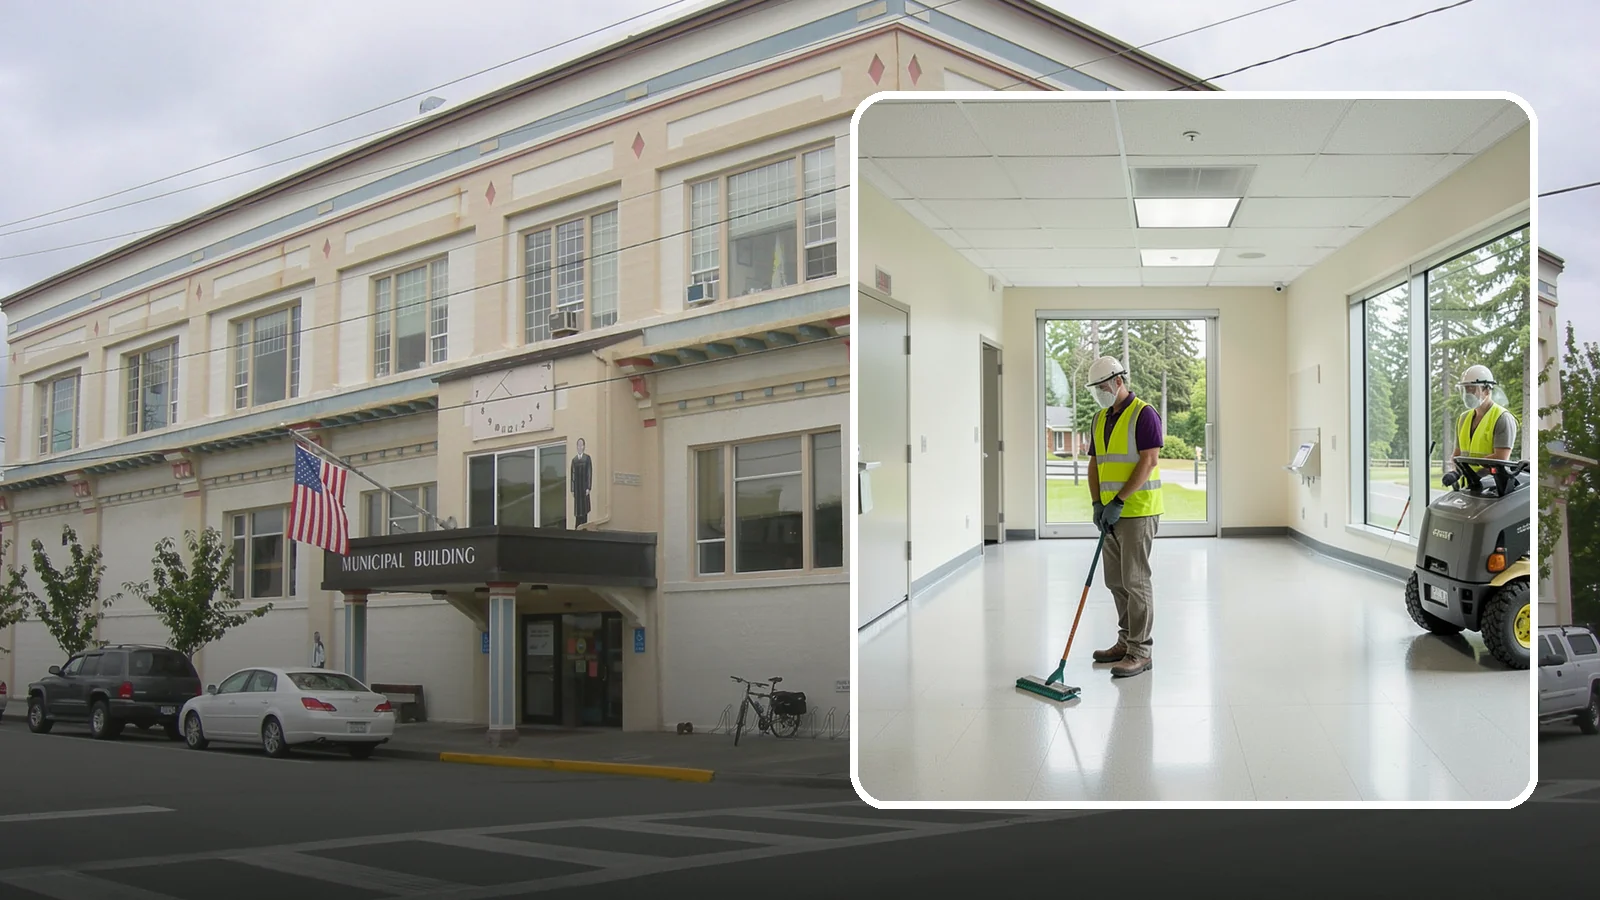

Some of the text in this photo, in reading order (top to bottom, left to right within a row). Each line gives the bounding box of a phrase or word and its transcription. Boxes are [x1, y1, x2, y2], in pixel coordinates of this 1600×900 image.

[481, 407, 485, 415] 8
[487, 417, 492, 426] 9
[494, 423, 500, 432] 10
[501, 425, 506, 434] 11
[507, 425, 513, 433] 12
[521, 420, 525, 428] 2
[529, 413, 533, 422] 3
[536, 402, 540, 410] 4
[342, 546, 475, 572] MUNICIPAL BUILDING
